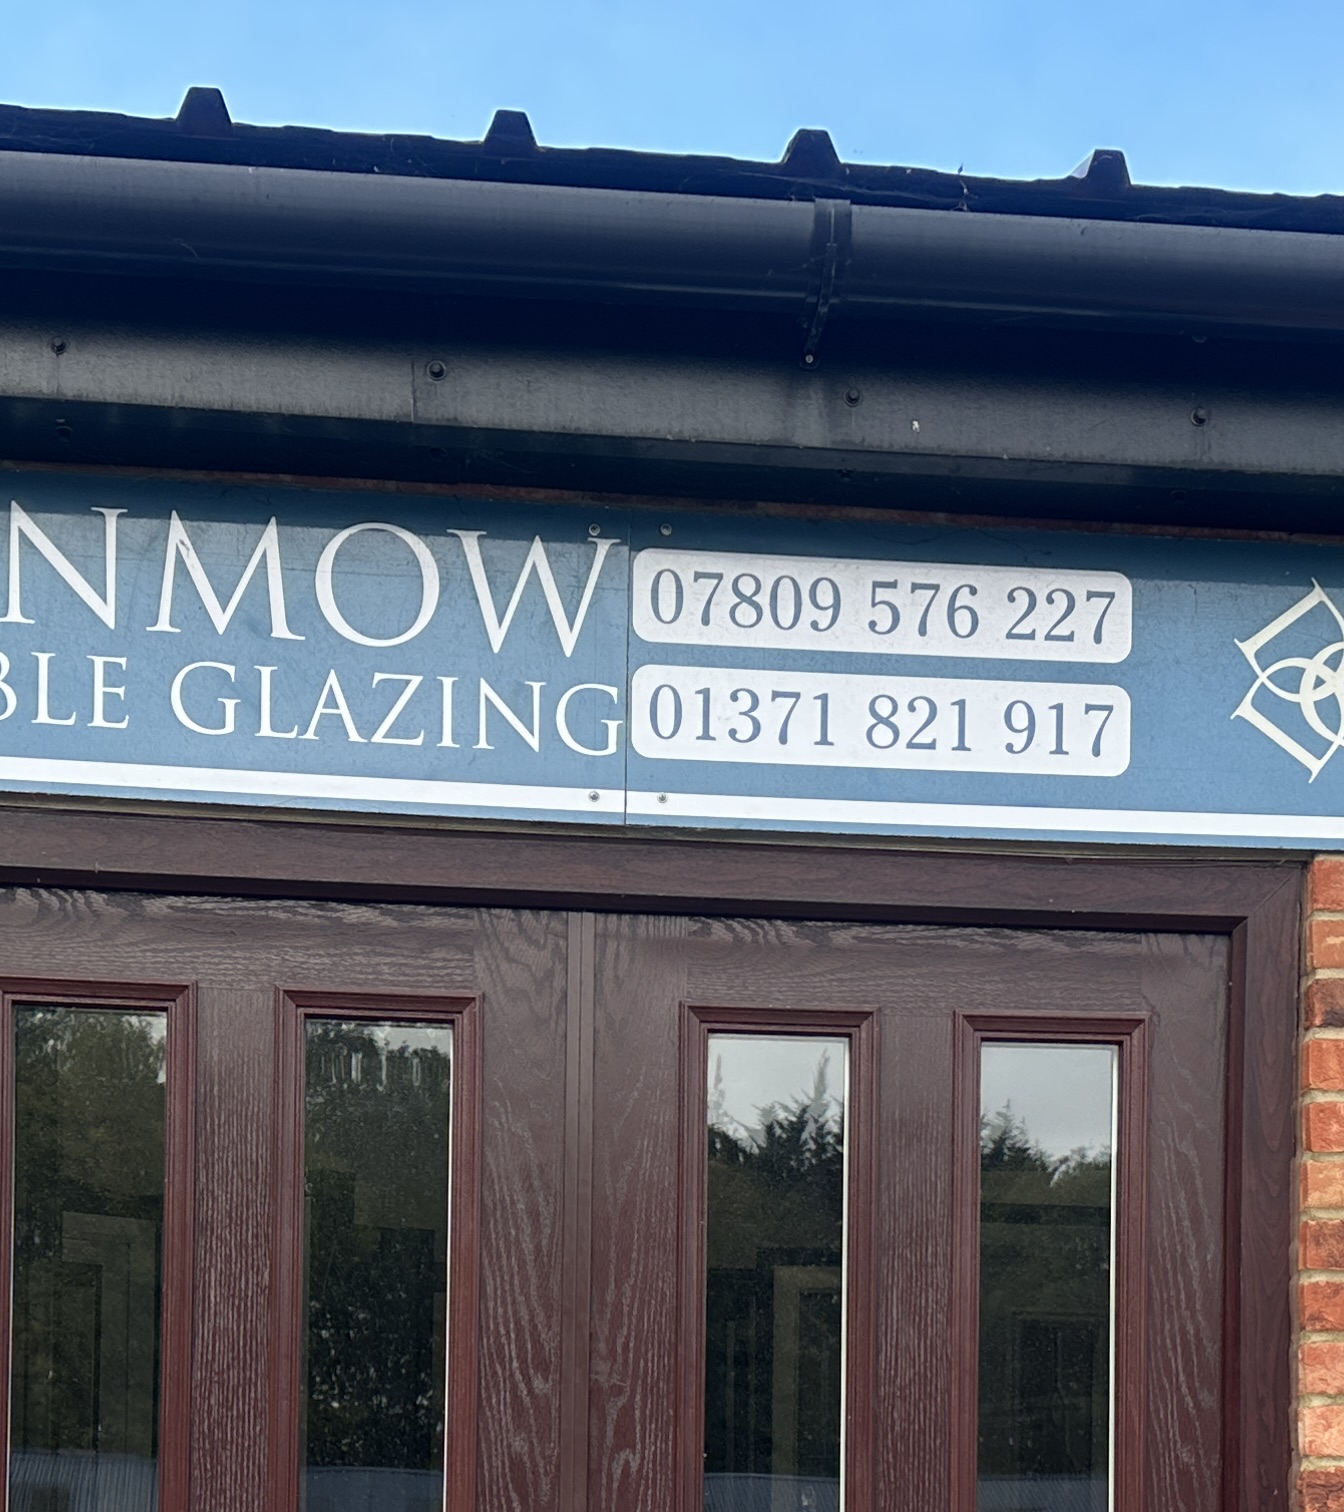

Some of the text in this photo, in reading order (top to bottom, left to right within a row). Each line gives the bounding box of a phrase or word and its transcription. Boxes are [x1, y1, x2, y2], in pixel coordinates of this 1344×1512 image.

[649, 567, 1117, 646] 07809 576 227
[169, 660, 626, 757] GLAZING
[649, 683, 1115, 758] 01371 821 917
